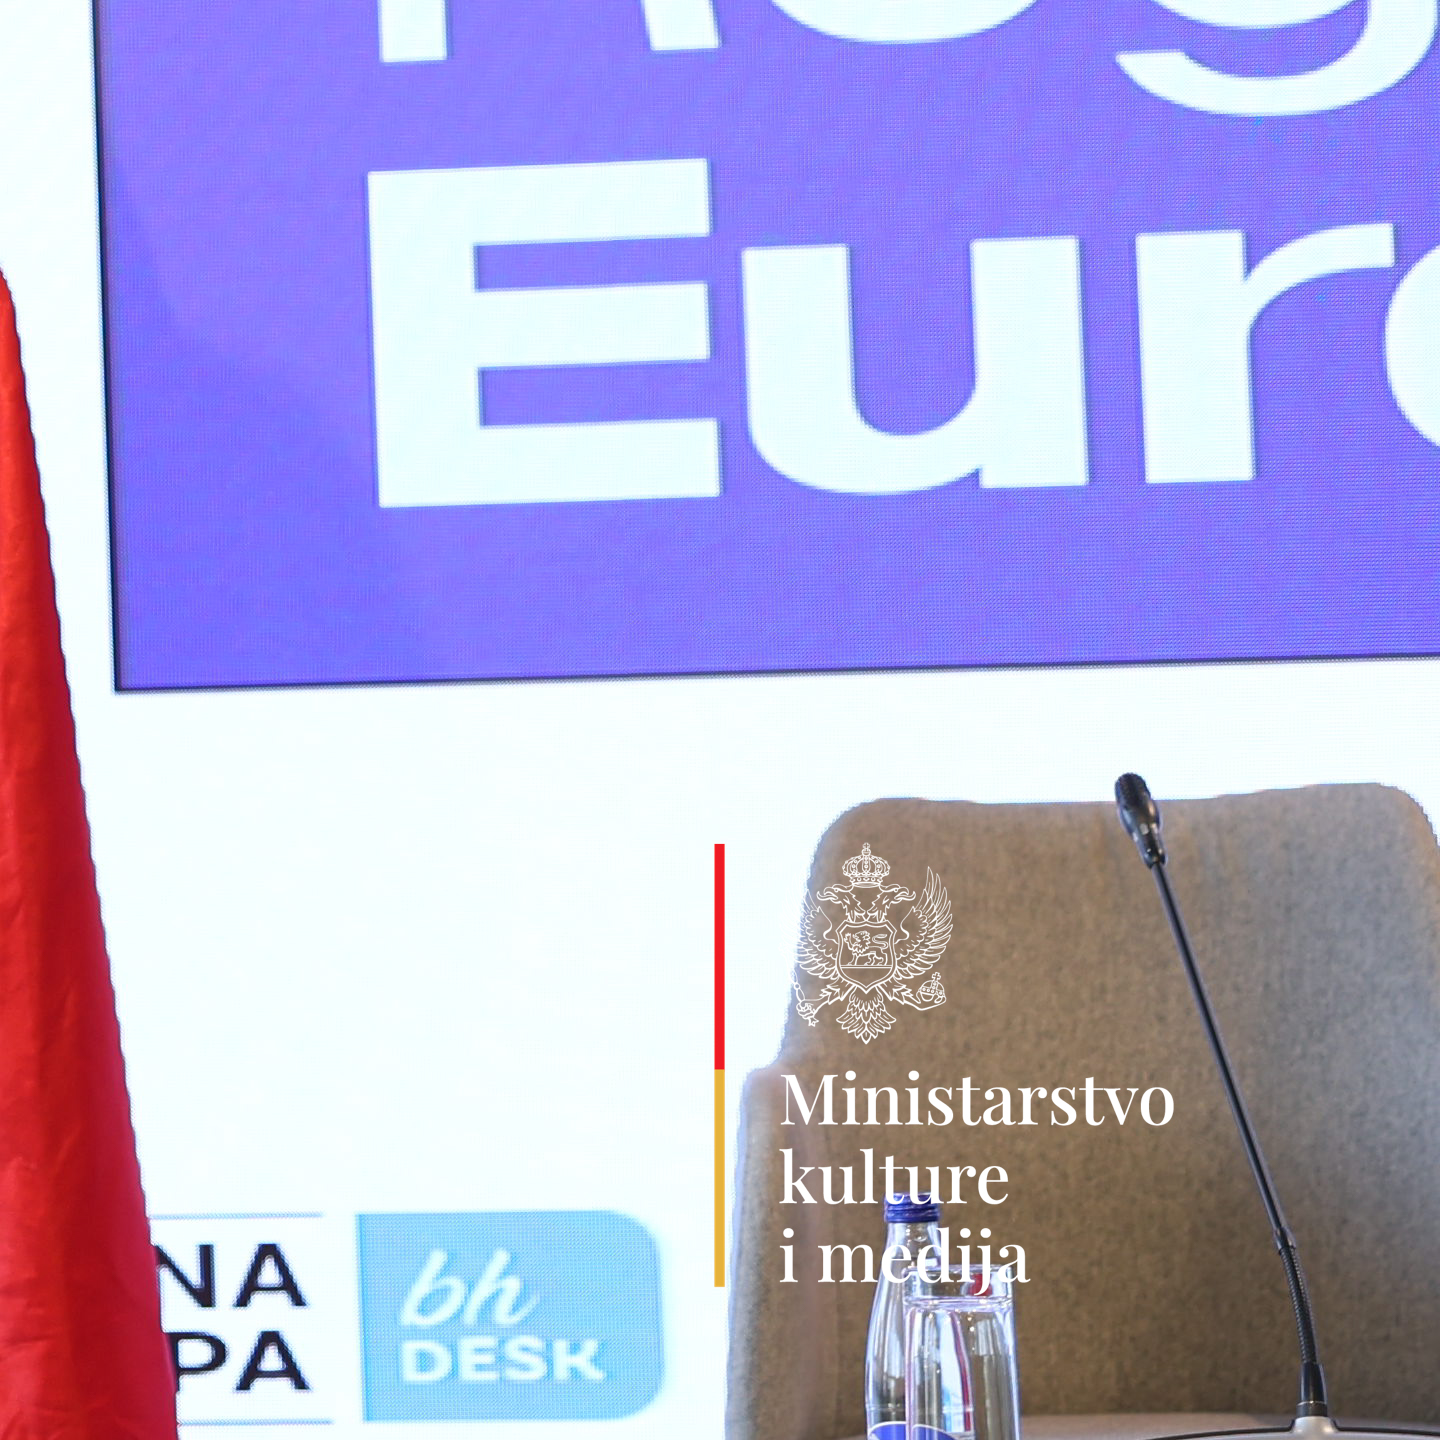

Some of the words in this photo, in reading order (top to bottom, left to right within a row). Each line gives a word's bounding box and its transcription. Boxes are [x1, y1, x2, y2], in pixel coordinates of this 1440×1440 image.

[367, 157, 1440, 509] Eur
[400, 1248, 541, 1329] bh
[401, 1335, 607, 1385] DESK
